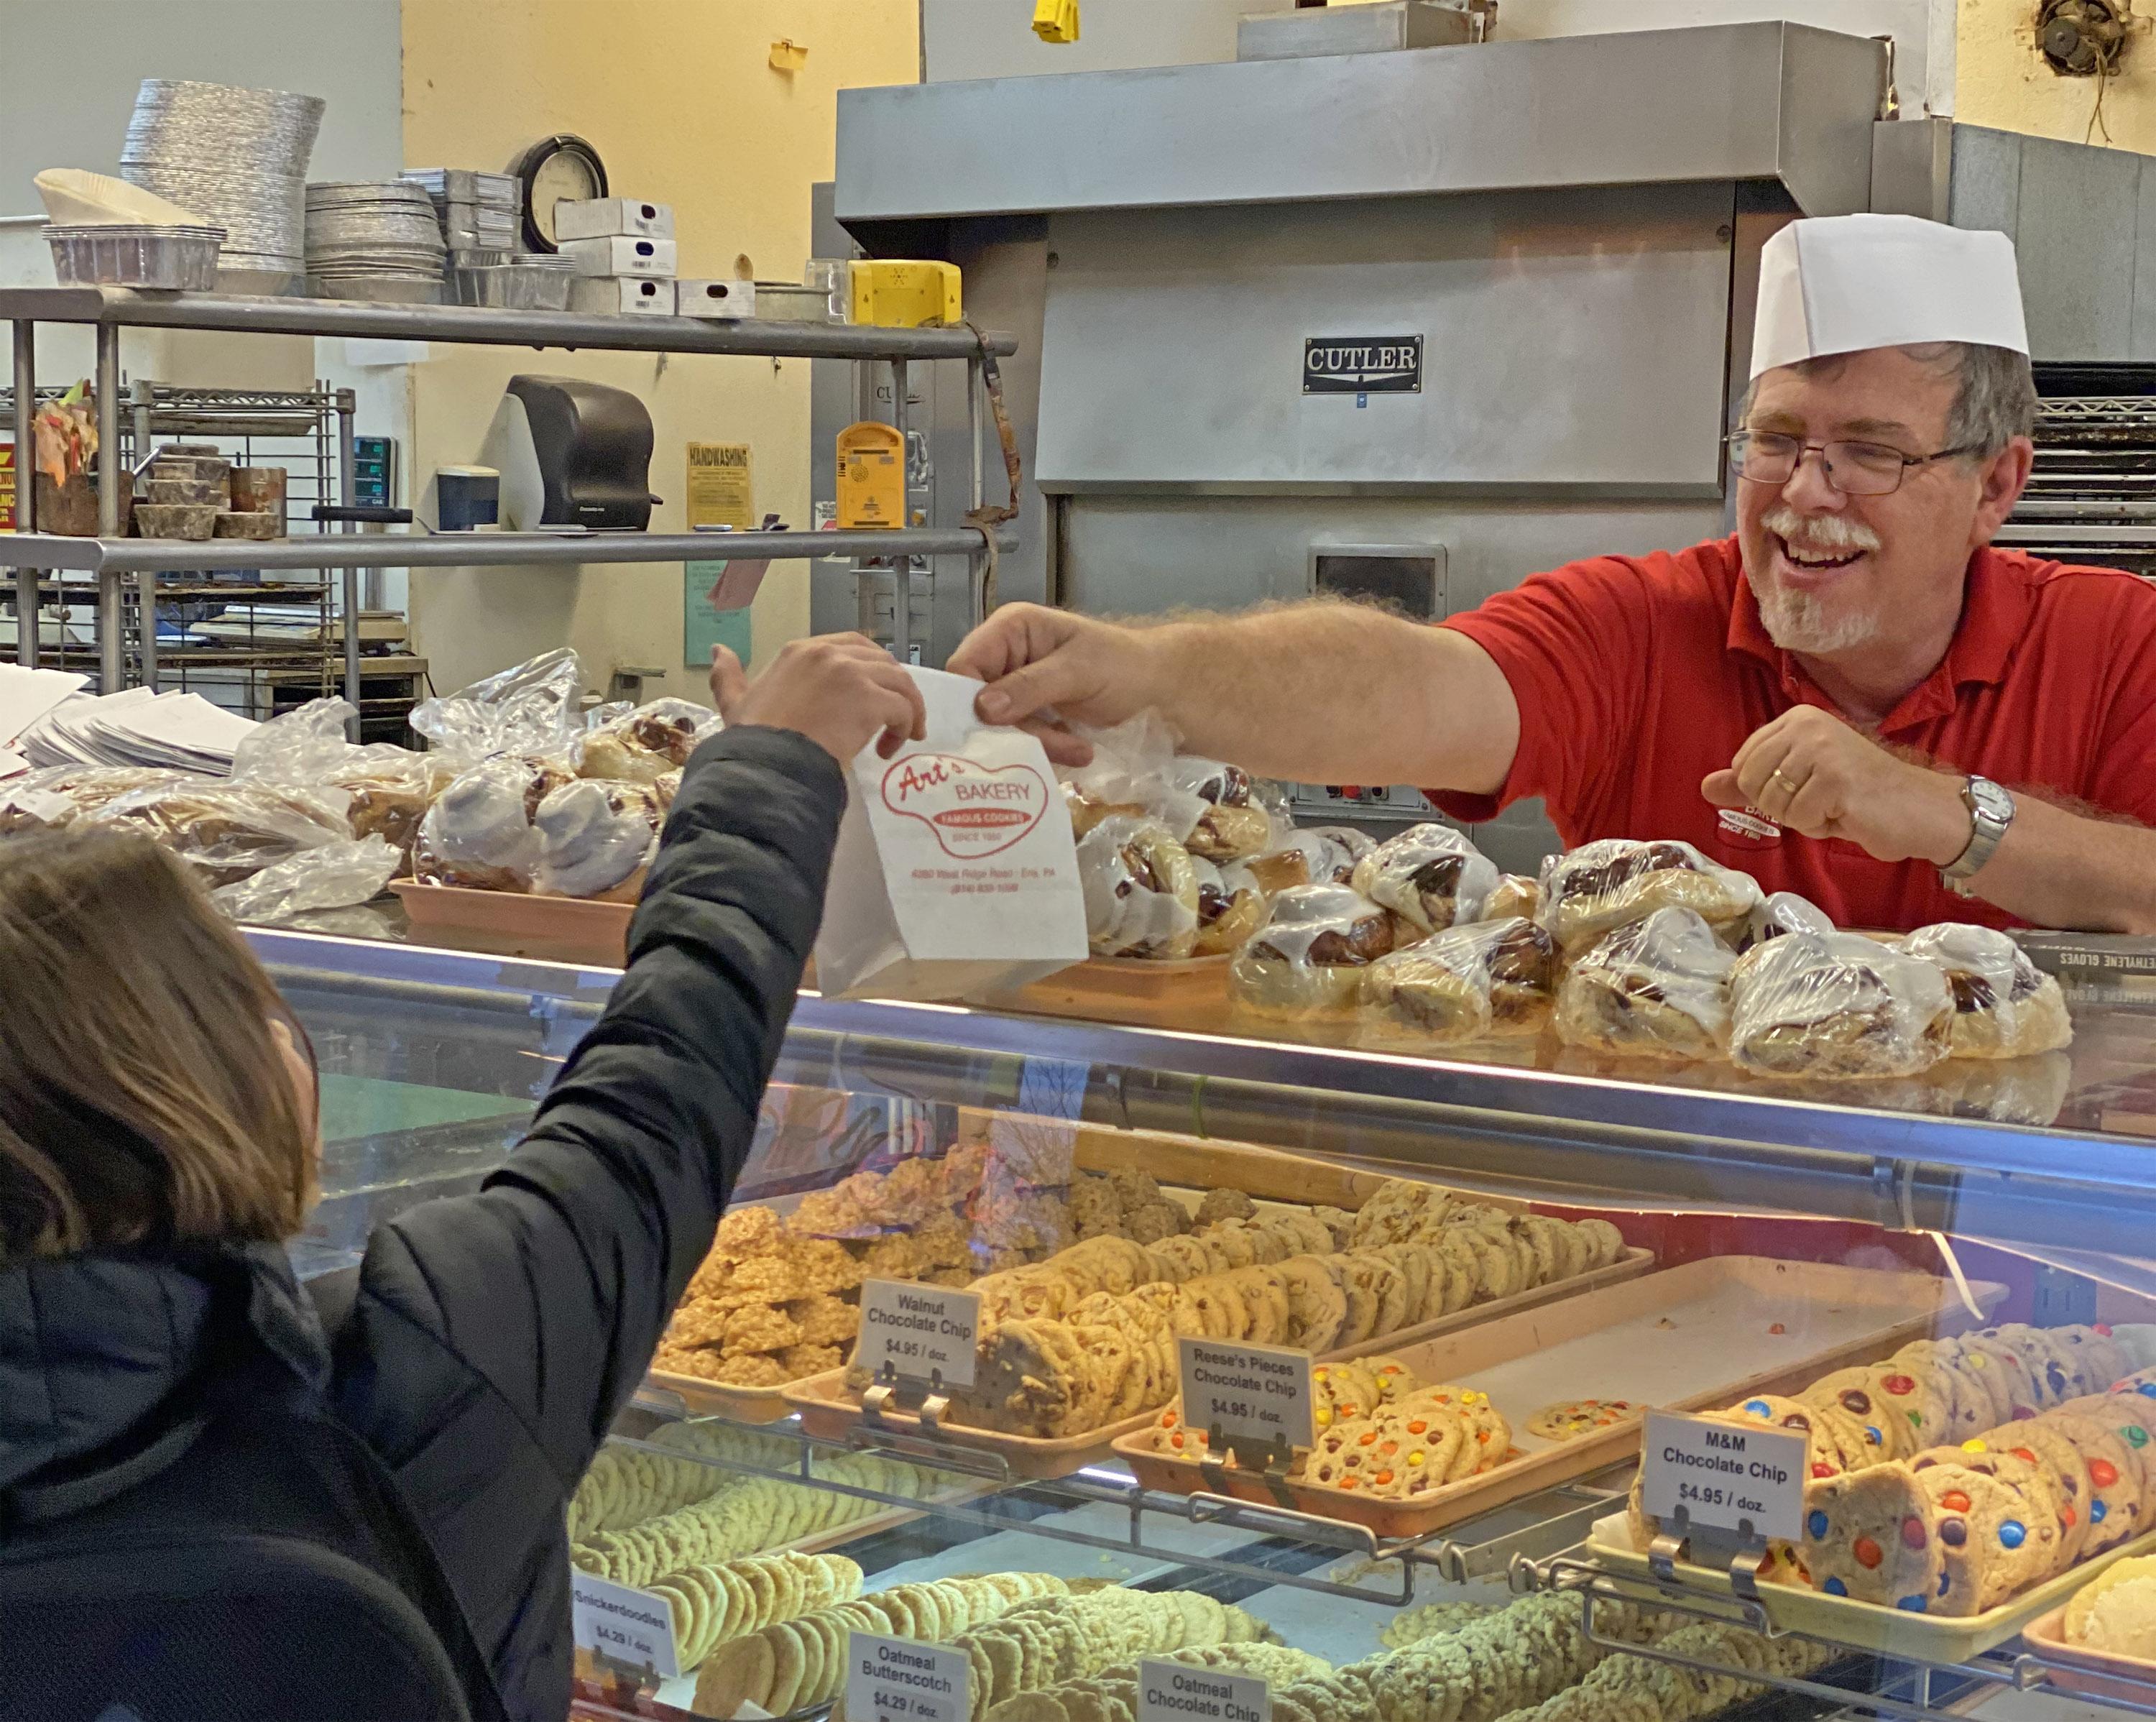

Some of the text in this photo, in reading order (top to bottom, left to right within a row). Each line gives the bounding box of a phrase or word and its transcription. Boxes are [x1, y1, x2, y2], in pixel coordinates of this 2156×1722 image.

[1307, 346, 1417, 371] CUTLER
[690, 447, 747, 466] HANDWASHING
[899, 755, 965, 802] Art's
[955, 783, 1030, 801] BAKERY
[941, 813, 1025, 824] FAMOUS COOKIES
[2060, 952, 2100, 966] GLOVES
[898, 1294, 944, 1316] Walnut
[868, 1307, 972, 1341] Chocolate Chip
[885, 1338, 918, 1356] $4.95
[929, 1348, 950, 1363] doz.
[1194, 1348, 1294, 1376] Reese's Pieces
[1194, 1368, 1296, 1400] Chocolate Chip
[1212, 1398, 1248, 1417] $4.95
[1259, 1409, 1284, 1424] doz.
[1705, 1431, 1746, 1452] M&M
[1663, 1447, 1788, 1485] Chocolate Chip
[1680, 1482, 1766, 1513] $4.95 / doz.
[575, 1590, 666, 1630] Snickerdoodles
[878, 1646, 936, 1671] Oatmeal
[862, 1659, 952, 1693] Butterscotch
[1172, 1675, 1233, 1700] Oatmeal
[874, 1691, 906, 1711] $4.29
[917, 1704, 939, 1718] doz.
[1147, 1688, 1261, 1722] Chocolate Chip
